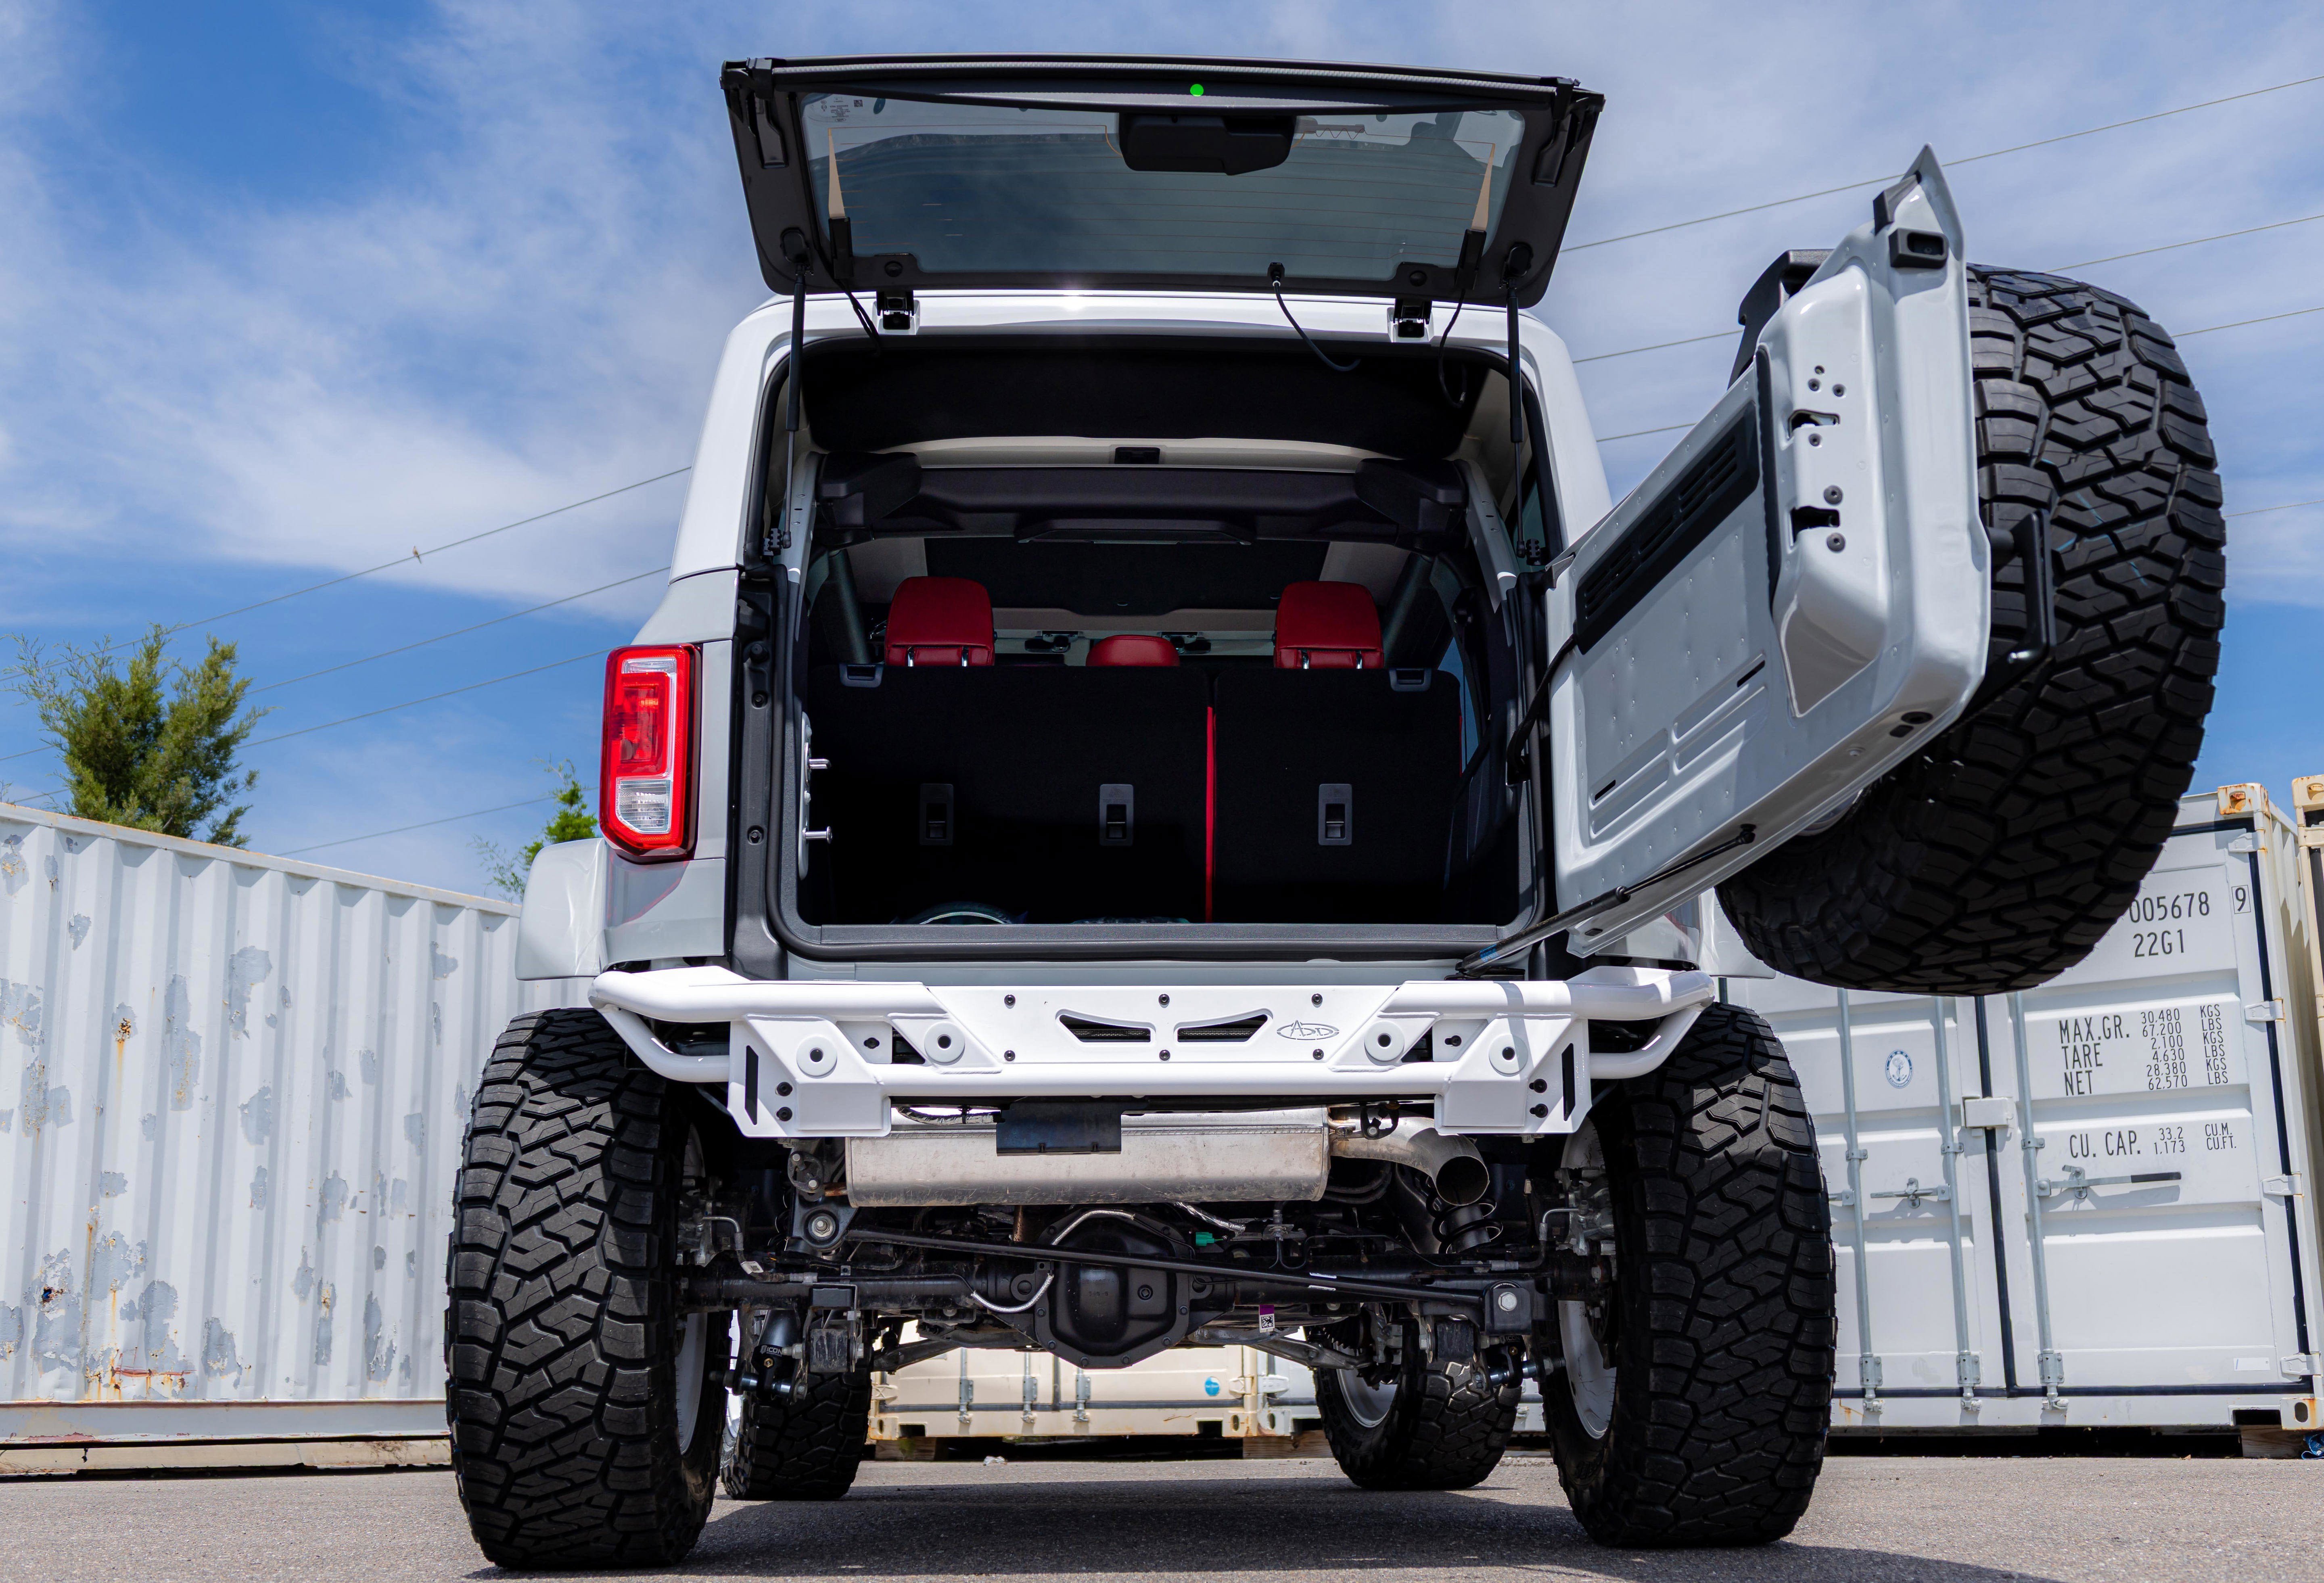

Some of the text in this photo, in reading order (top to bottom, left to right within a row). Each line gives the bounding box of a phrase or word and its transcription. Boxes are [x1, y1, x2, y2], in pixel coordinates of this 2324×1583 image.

[2129, 887, 2246, 923] 005678 9
[2133, 929, 2184, 958] 22G1
[2059, 1004, 2220, 1044] MAX.GR. 30,480 KGS
[2142, 1018, 2222, 1037] 67,200 LBS
[2061, 1031, 2224, 1070] TARE 2,100 KGS
[2153, 1044, 2225, 1062] 4,630 LBS
[2064, 1058, 2227, 1096] NET 28,380 KGS
[2148, 1071, 2228, 1090] 62,570 LBS
[2070, 1123, 2232, 1158] CU. CAP. 33.2 CU.M.
[2154, 1135, 2236, 1154] 1,173 CU.FT.
[766, 1347, 782, 1355] ICON
